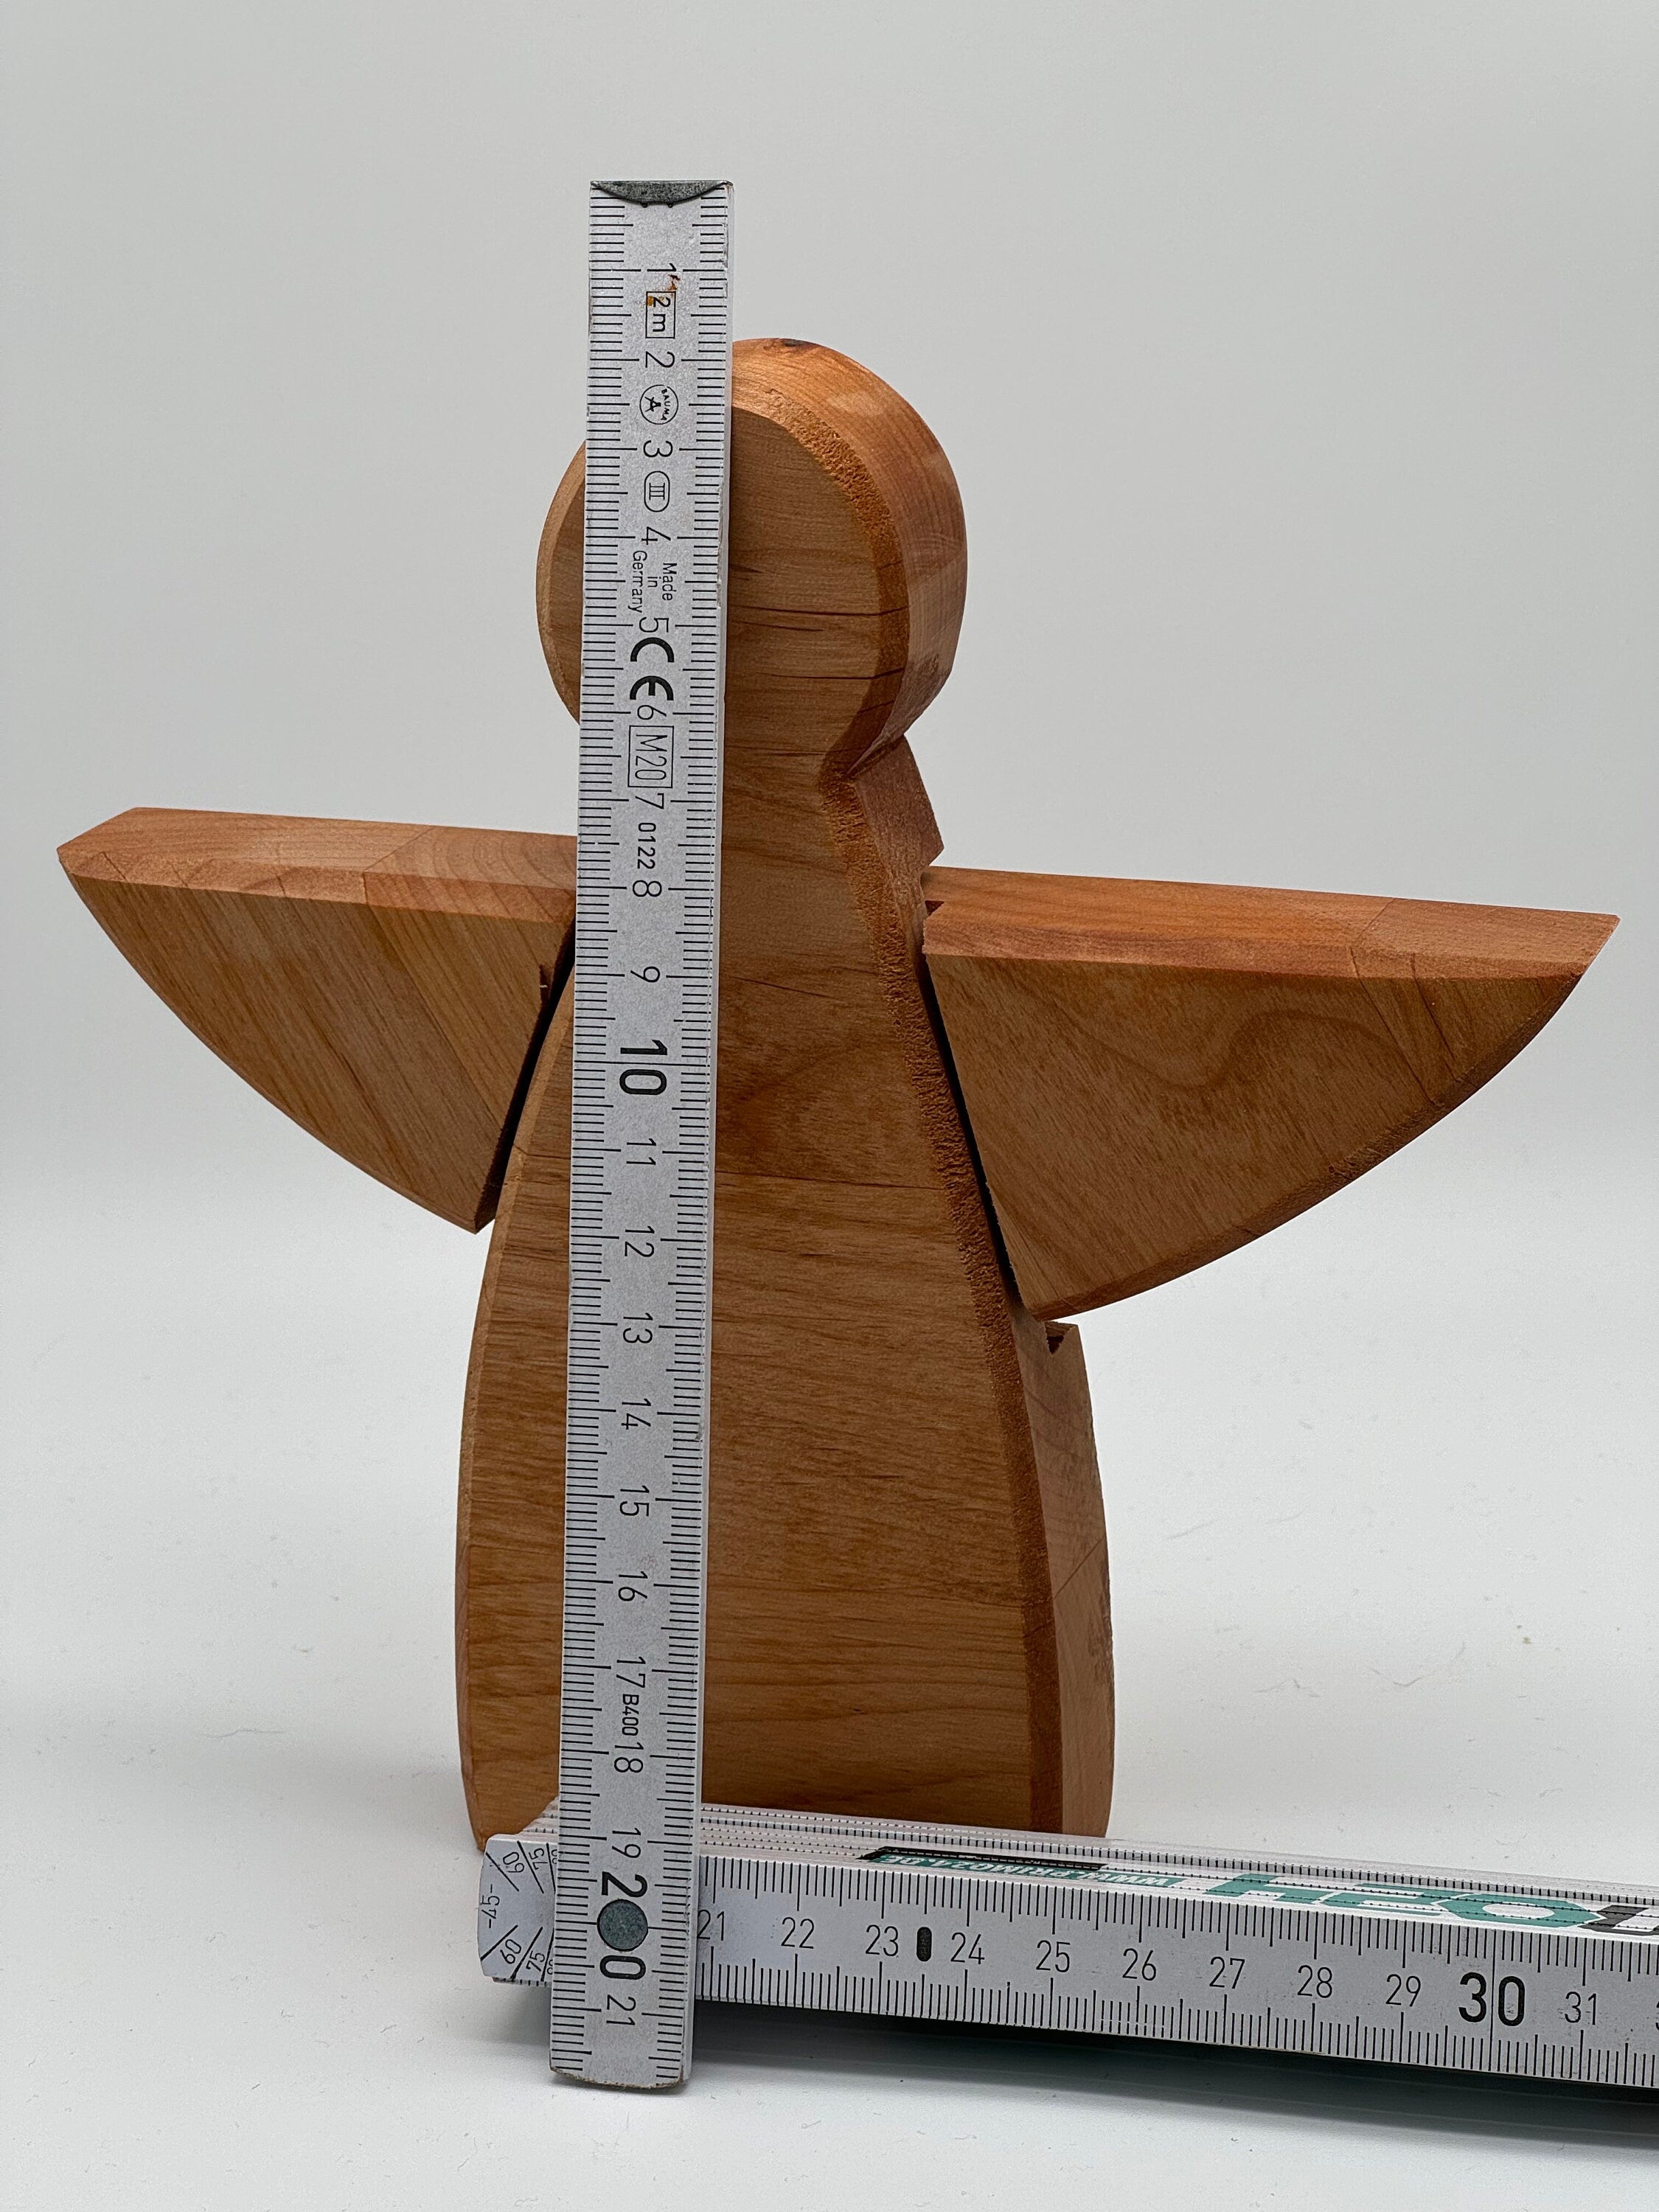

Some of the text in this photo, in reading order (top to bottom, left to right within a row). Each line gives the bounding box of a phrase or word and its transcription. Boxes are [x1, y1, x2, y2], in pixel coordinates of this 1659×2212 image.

[644, 350, 675, 369] 2
[660, 388, 671, 421] BAUMA
[642, 439, 673, 458] 3
[641, 526, 672, 546] 4
[627, 550, 648, 613] Germany
[647, 576, 658, 588] in
[661, 563, 675, 601] Made
[639, 616, 669, 633] 5
[636, 704, 667, 720] 6
[634, 734, 668, 781] M20
[634, 792, 665, 810] 7
[636, 822, 657, 869] 0122
[632, 879, 663, 898] 8
[630, 966, 661, 984] 9
[619, 1039, 668, 1096] 10
[625, 1138, 657, 1166] 11
[624, 1225, 655, 1258] 12
[622, 1312, 654, 1344] 13
[620, 1397, 652, 1430] 14
[619, 1484, 650, 1517] 15
[617, 1571, 649, 1602] 16
[616, 1656, 647, 1688] 17
[621, 1693, 640, 1736] B400
[613, 1739, 644, 1773] 18
[611, 1827, 641, 1859] 19
[1203, 1873, 1659, 1936] O24
[696, 1909, 1597, 2028] 21 22 23 24 25 26 27 28 29 30 31
[605, 1994, 637, 2026] 21
